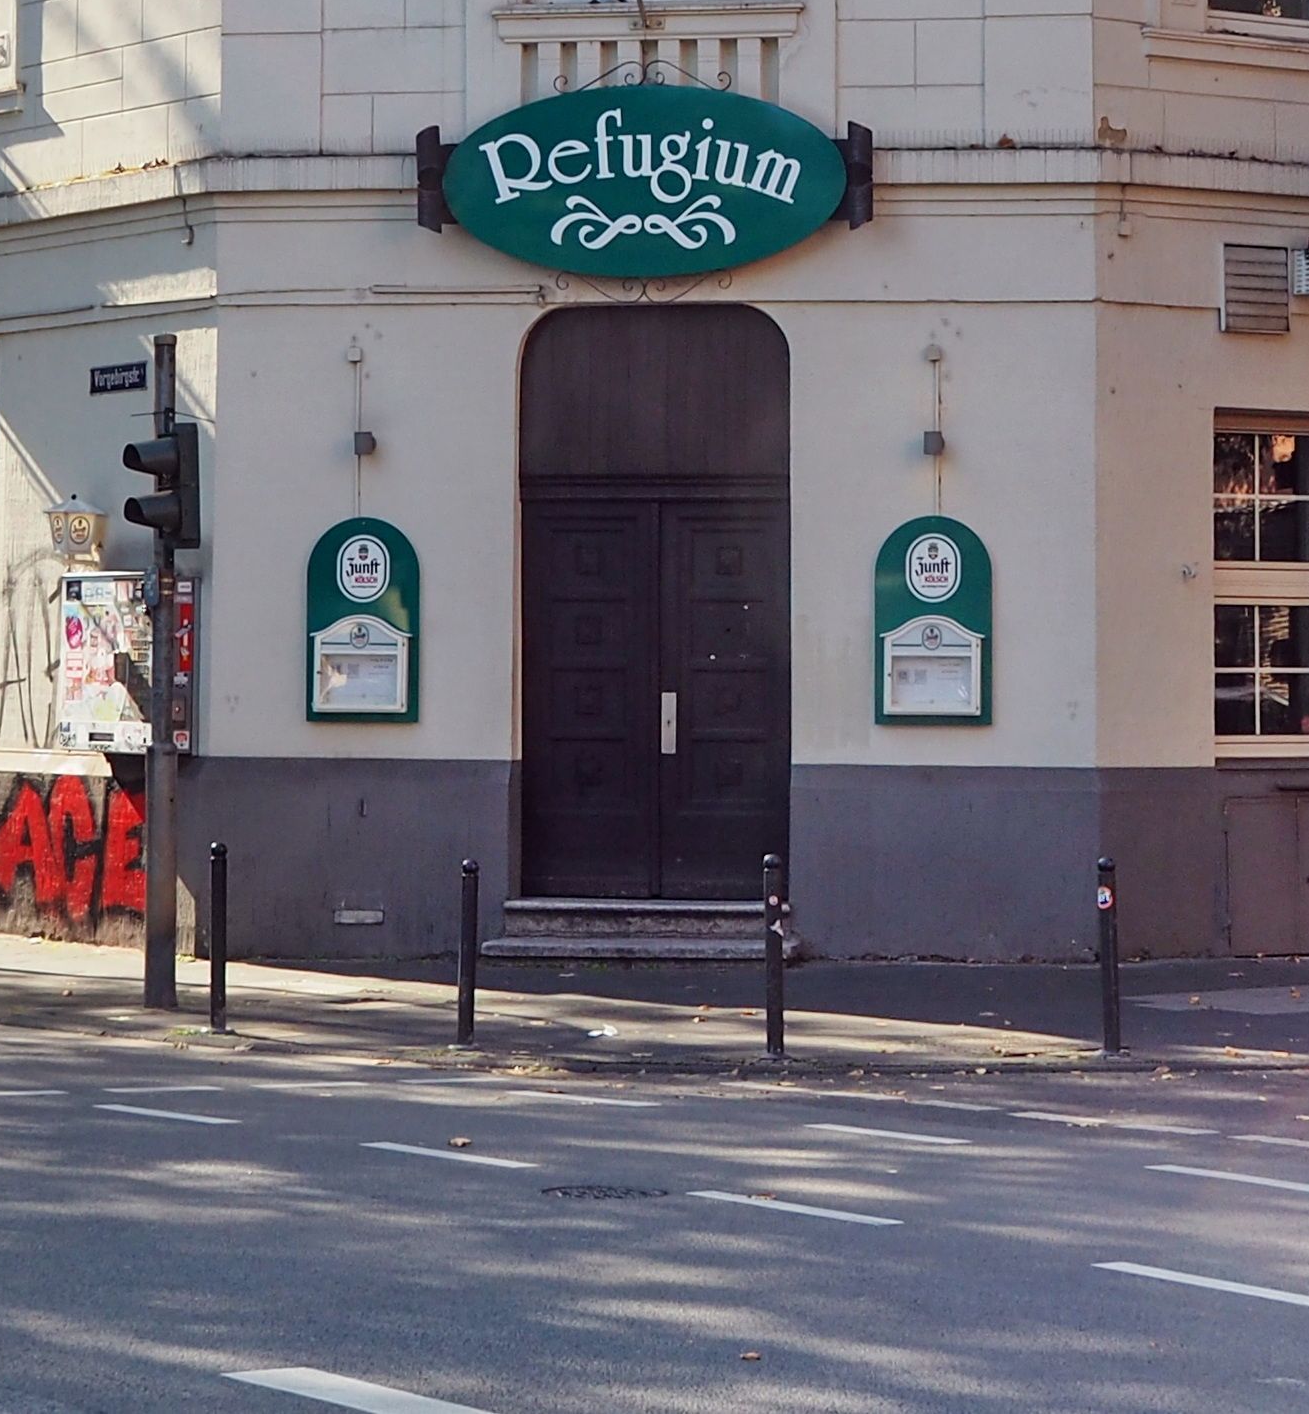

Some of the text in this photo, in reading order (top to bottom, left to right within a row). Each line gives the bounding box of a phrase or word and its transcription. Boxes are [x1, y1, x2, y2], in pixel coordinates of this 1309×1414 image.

[478, 107, 802, 205] Refugium
[345, 557, 381, 577] Zunft
[915, 556, 952, 577] Zunft
